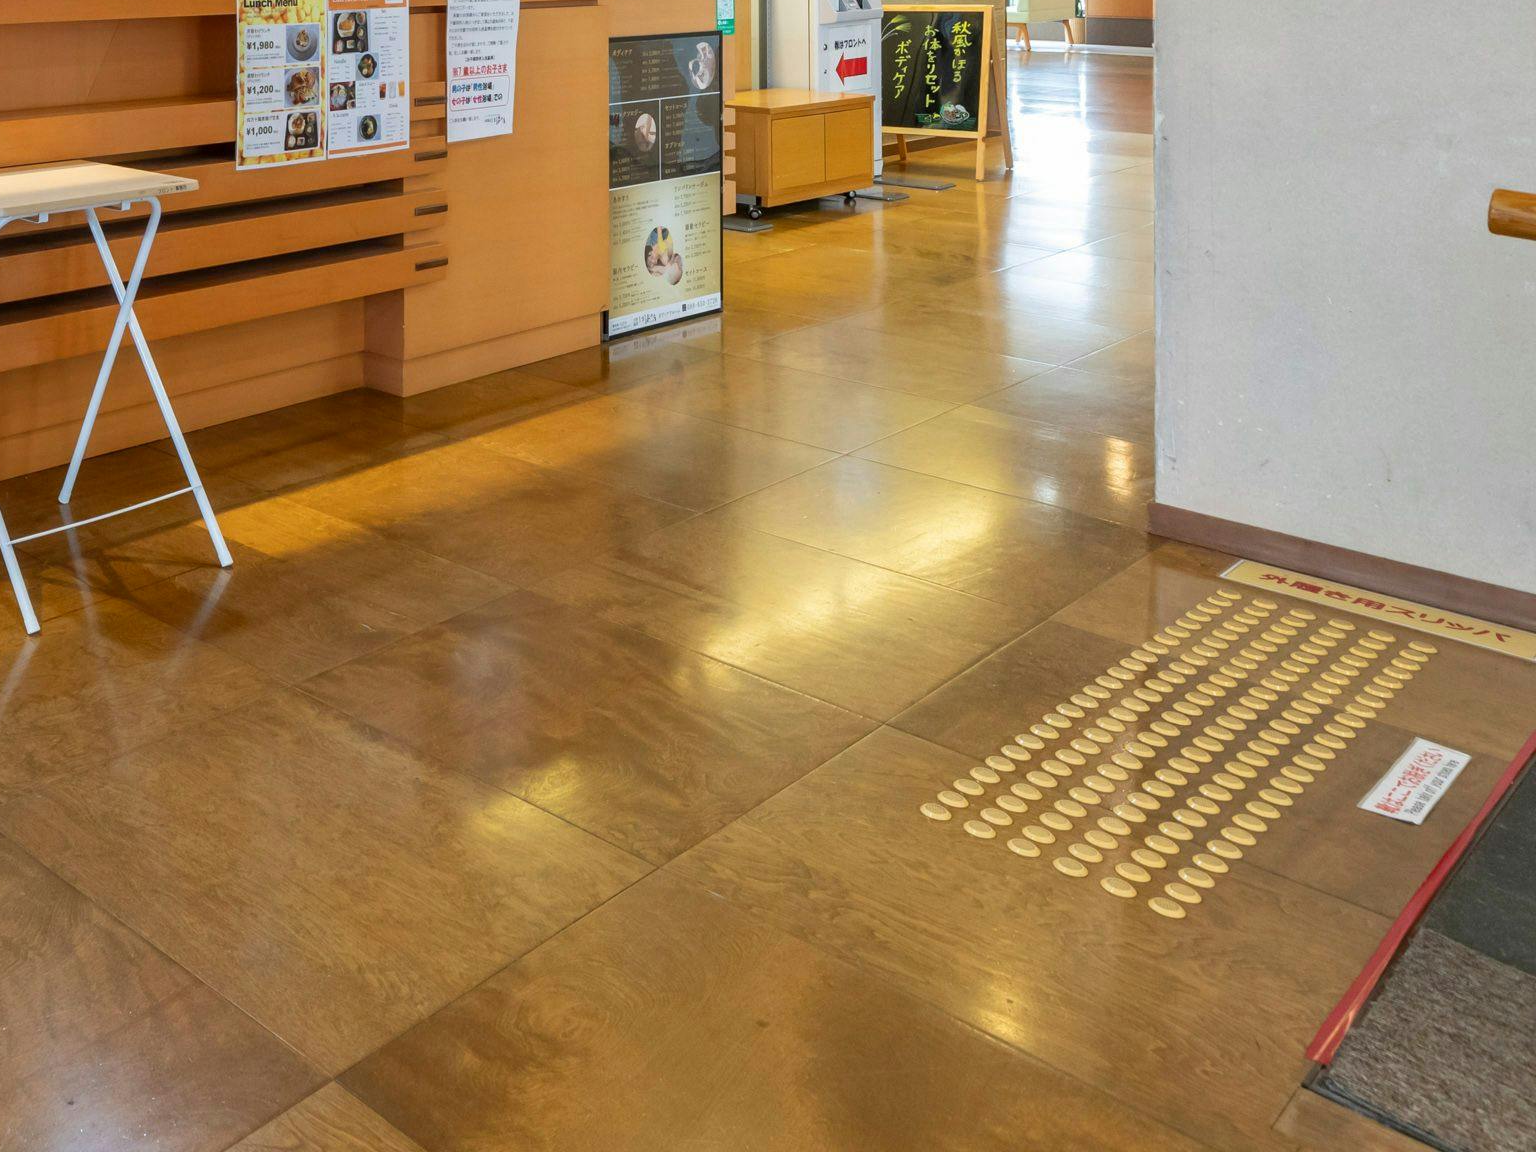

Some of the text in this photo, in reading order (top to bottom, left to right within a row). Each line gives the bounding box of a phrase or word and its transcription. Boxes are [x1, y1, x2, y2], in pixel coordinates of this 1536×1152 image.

[246, 40, 275, 51] ¥1,980
[892, 39, 912, 99] ボディケア
[922, 24, 943, 108] お体をリセット
[951, 20, 972, 83] 秋風かほる
[246, 84, 274, 96] ¥1,200
[246, 125, 273, 137] ¥1,000
[1258, 572, 1512, 643] 外履き用スリッパ
